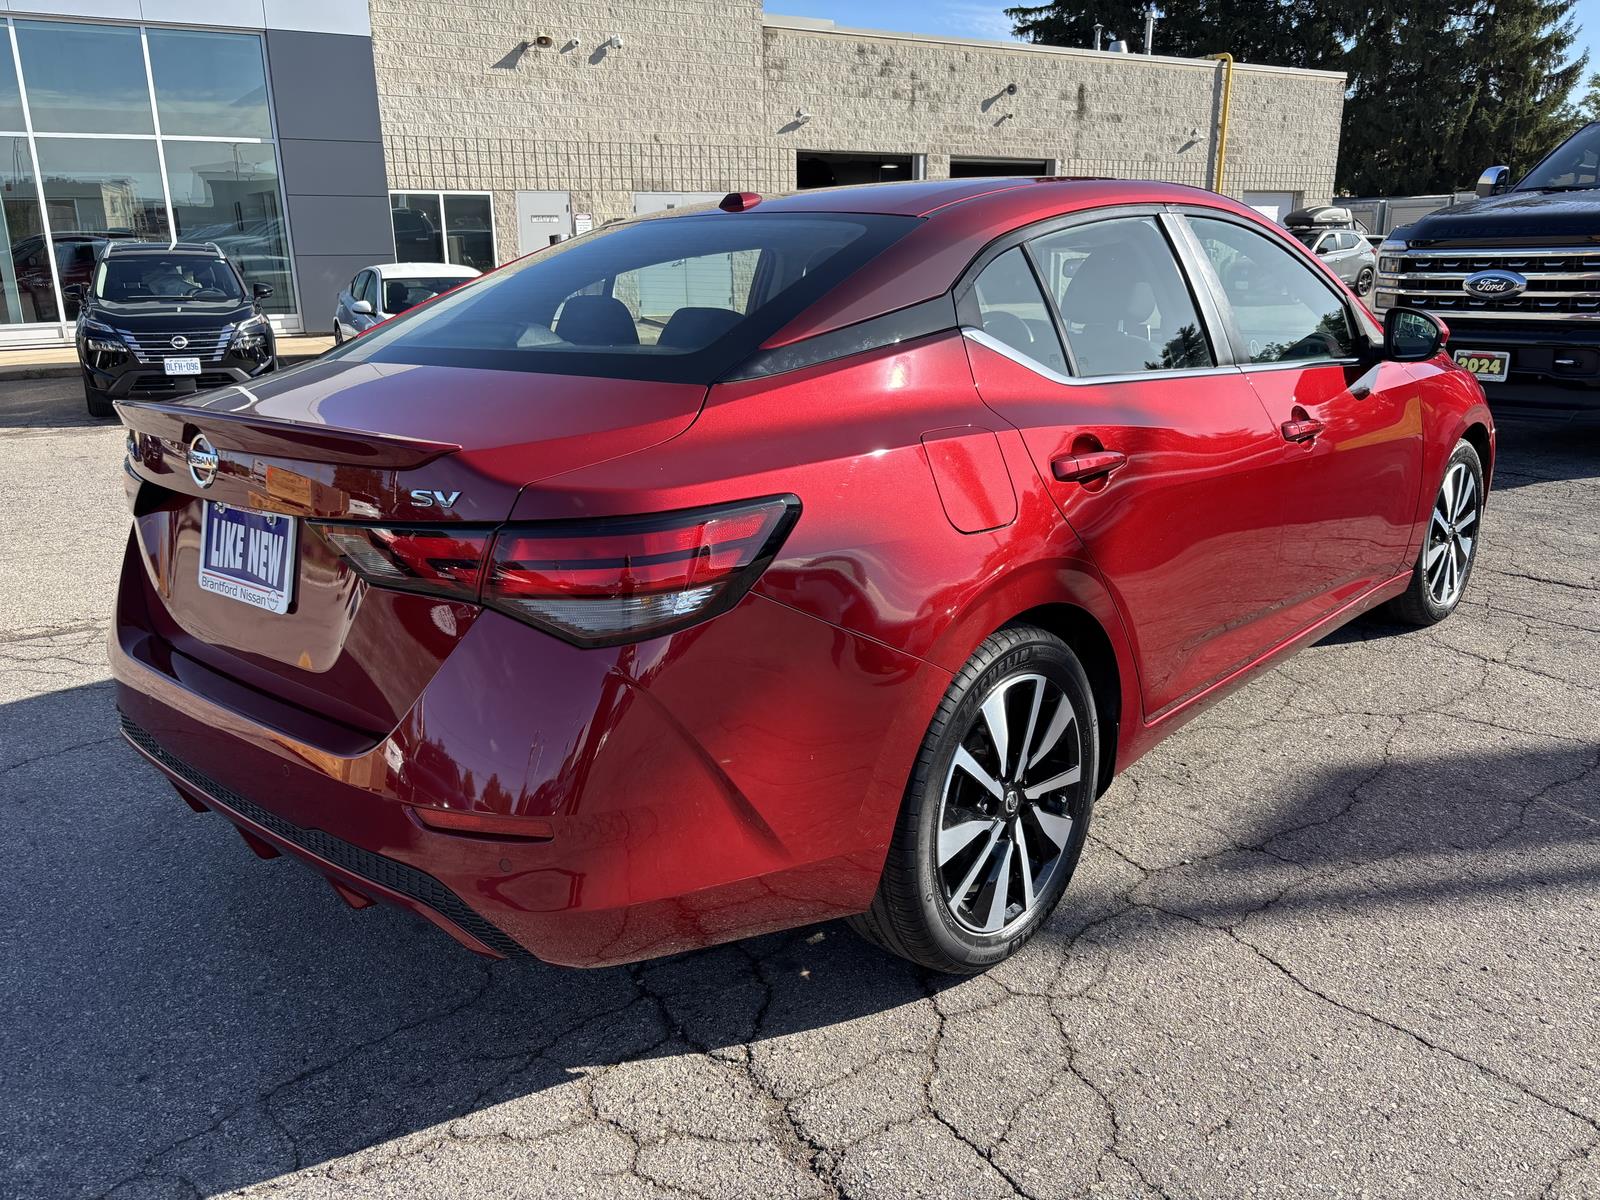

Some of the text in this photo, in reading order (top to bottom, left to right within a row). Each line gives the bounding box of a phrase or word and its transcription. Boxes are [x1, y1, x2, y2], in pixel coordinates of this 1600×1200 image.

[1477, 279, 1507, 291] Ford
[1458, 357, 1501, 374] 2024
[410, 489, 461, 507] SV
[210, 518, 285, 587] LIKE NEW
[201, 577, 267, 606] Brantford Nissan
